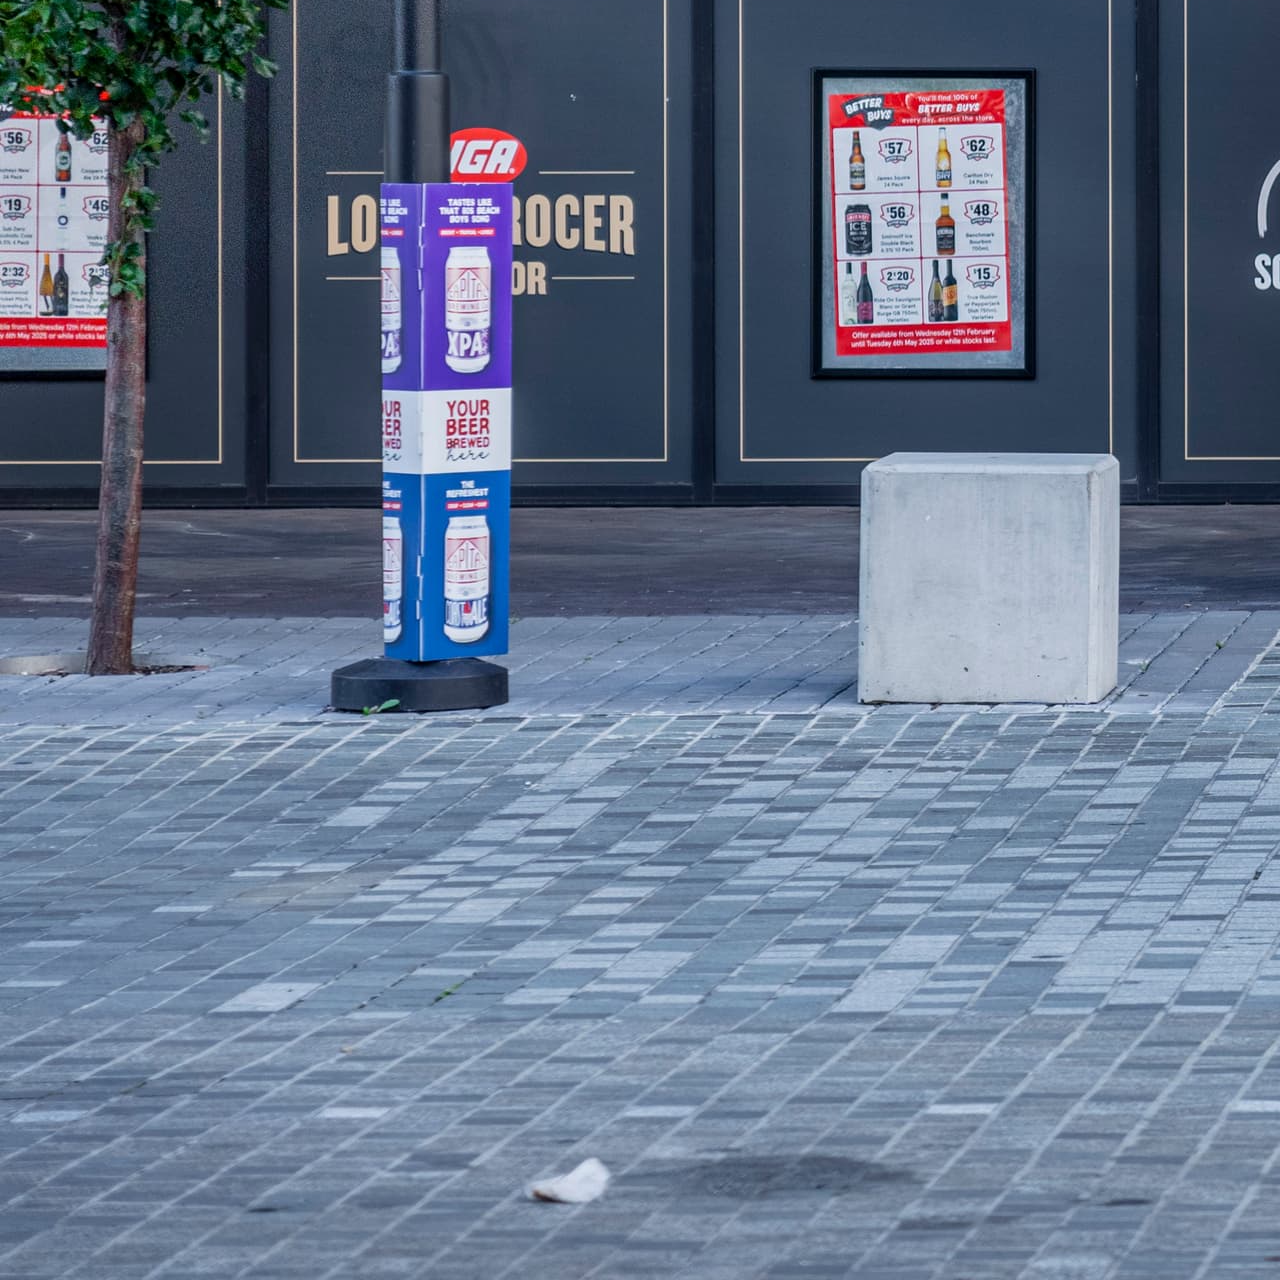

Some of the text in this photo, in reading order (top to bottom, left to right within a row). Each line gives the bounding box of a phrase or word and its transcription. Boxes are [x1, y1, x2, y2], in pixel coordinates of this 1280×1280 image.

[845, 97, 883, 115] BETTER
[918, 103, 981, 115] BETTER BUYS
[867, 109, 892, 122] BUYS
[884, 142, 904, 155] $57
[966, 139, 986, 153] $62
[450, 140, 519, 174] IGA
[886, 206, 906, 219] $56
[970, 203, 990, 217] $48
[512, 194, 635, 255] OCER
[973, 267, 991, 280] $15
[28, 323, 65, 332] Wednesday
[852, 331, 869, 339] Offer
[870, 330, 898, 338] available
[899, 329, 915, 337] from
[915, 328, 952, 338] Wednesday
[967, 328, 996, 337] February
[447, 331, 482, 357] XPA
[851, 340, 866, 348] until
[867, 339, 892, 349] Tuesday
[903, 339, 918, 348] May
[944, 337, 961, 345] while
[962, 337, 982, 345] stocks
[382, 400, 402, 417] UR
[446, 400, 490, 417] YOUR
[382, 419, 402, 436] ER
[446, 418, 490, 436] BEER
[446, 437, 490, 449] BREWED
[446, 449, 490, 461] here
